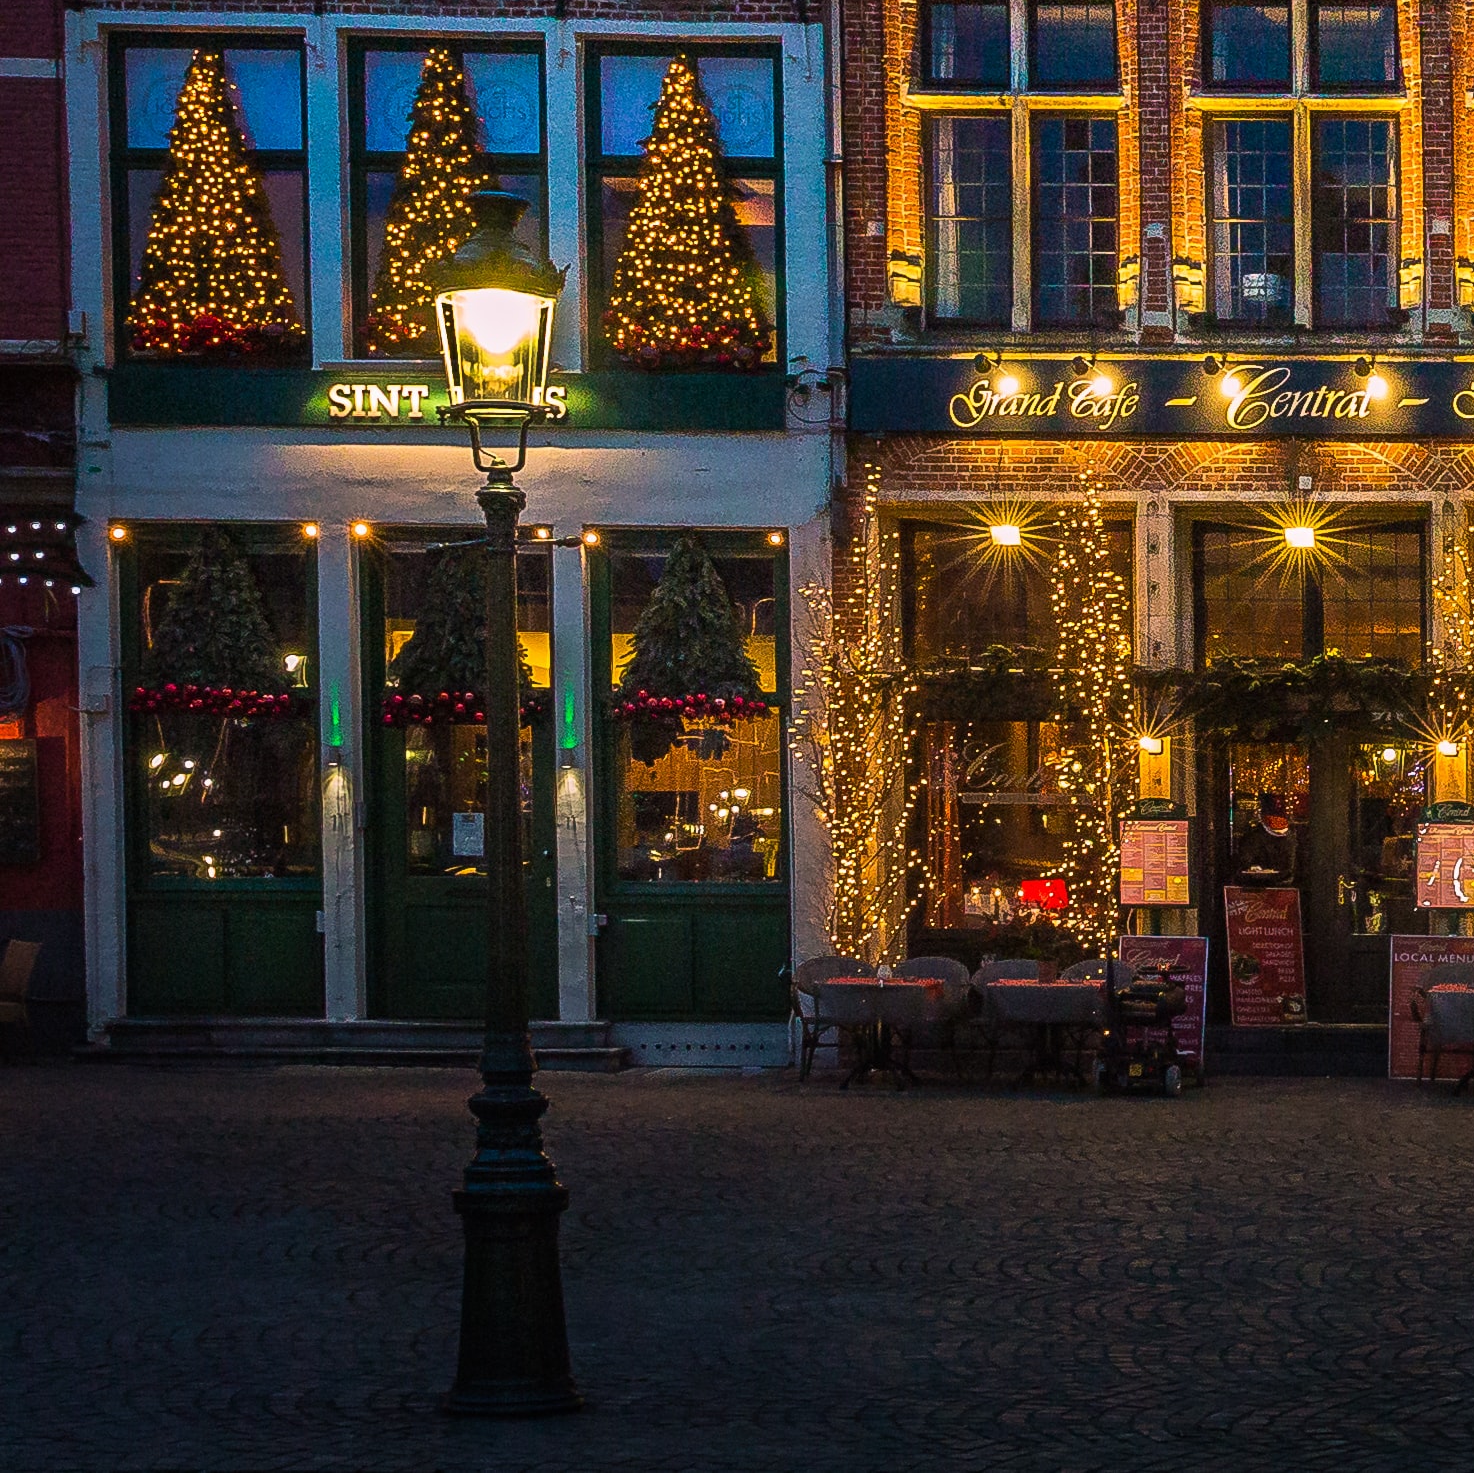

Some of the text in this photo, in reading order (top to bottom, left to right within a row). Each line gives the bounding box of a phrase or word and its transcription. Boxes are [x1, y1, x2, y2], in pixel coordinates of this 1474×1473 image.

[328, 383, 429, 418] SINT
[949, 379, 1061, 428] Grand
[1224, 364, 1374, 430] Central
[1238, 926, 1294, 937] LIGHT LUNCH
[1393, 952, 1474, 964] LOCAL MENU
